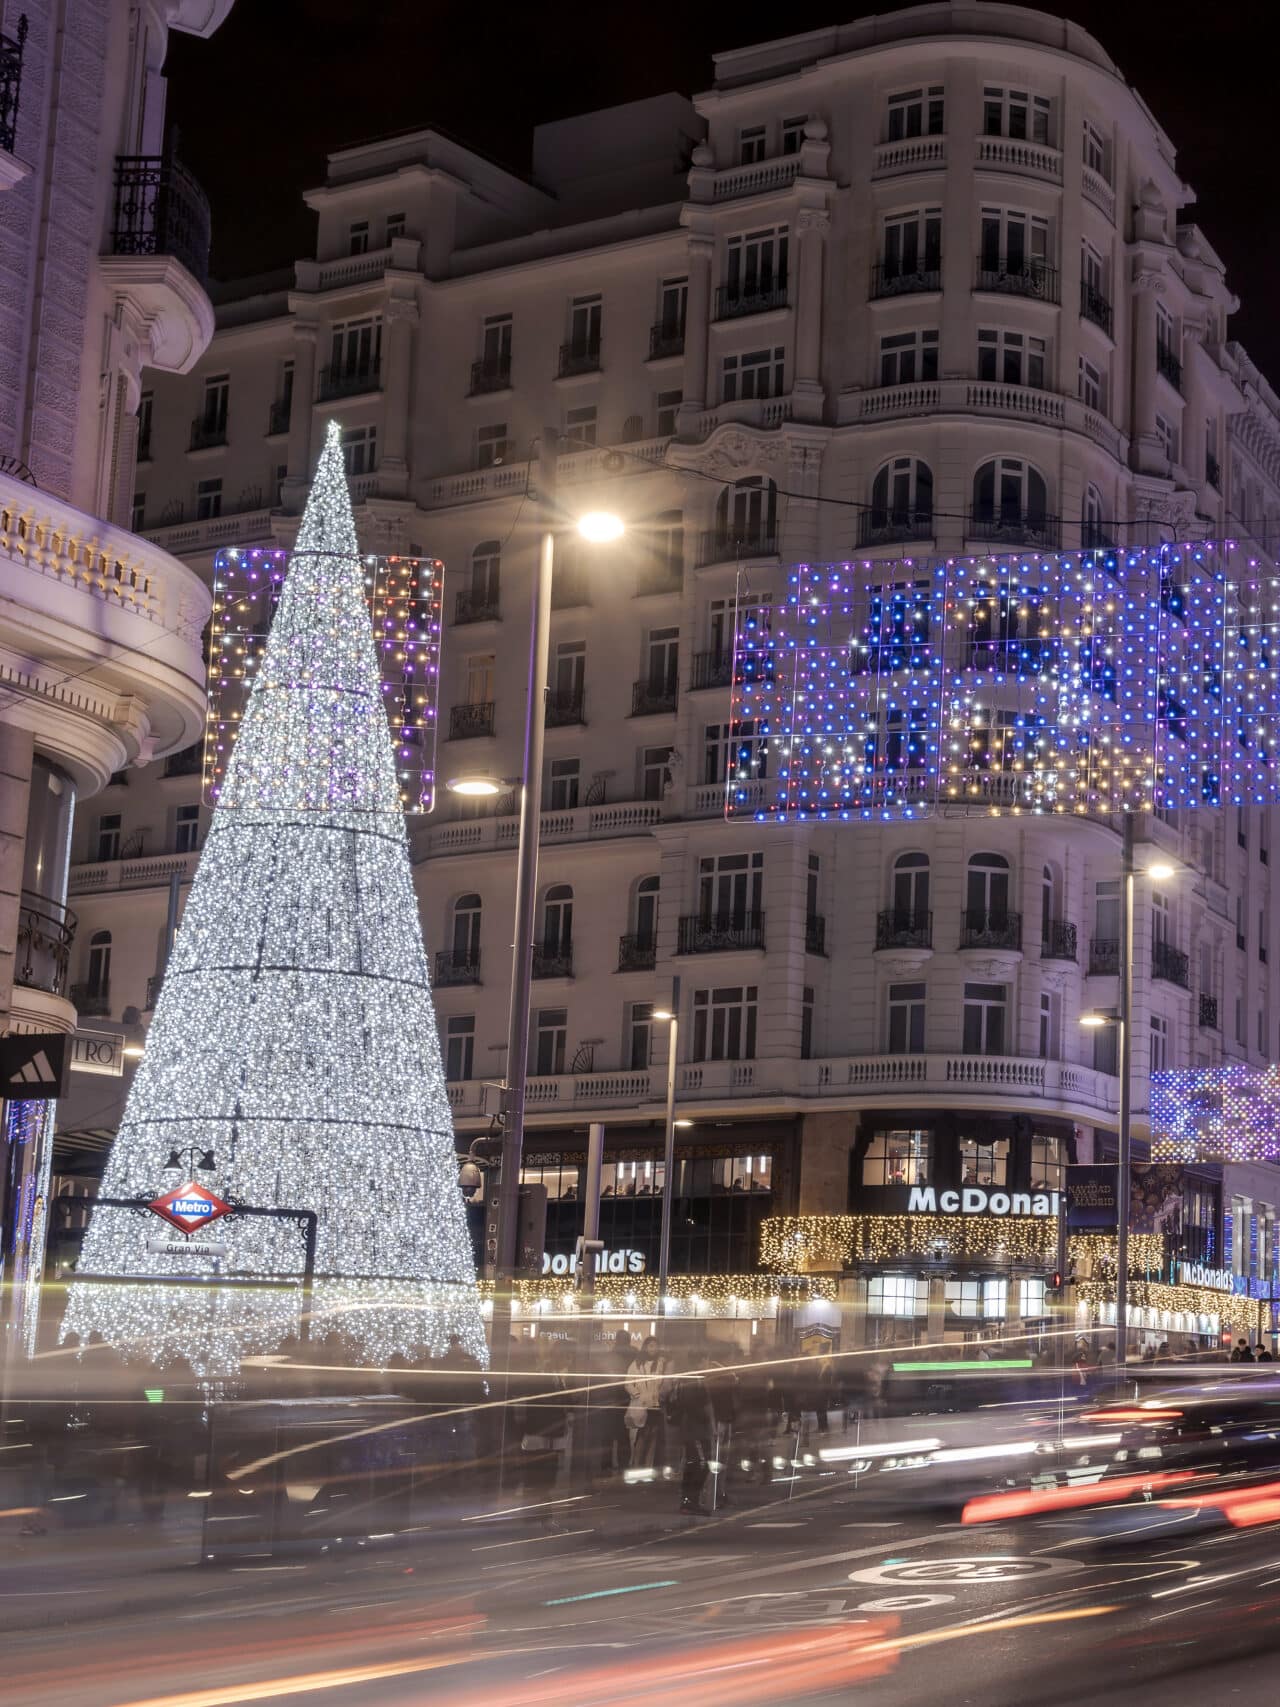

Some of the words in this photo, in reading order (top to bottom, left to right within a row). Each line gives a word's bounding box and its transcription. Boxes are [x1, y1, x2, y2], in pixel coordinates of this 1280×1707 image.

[175, 1200, 210, 1213] Metro
[908, 1186, 1060, 1216] McDonal
[166, 1244, 191, 1253] Gran
